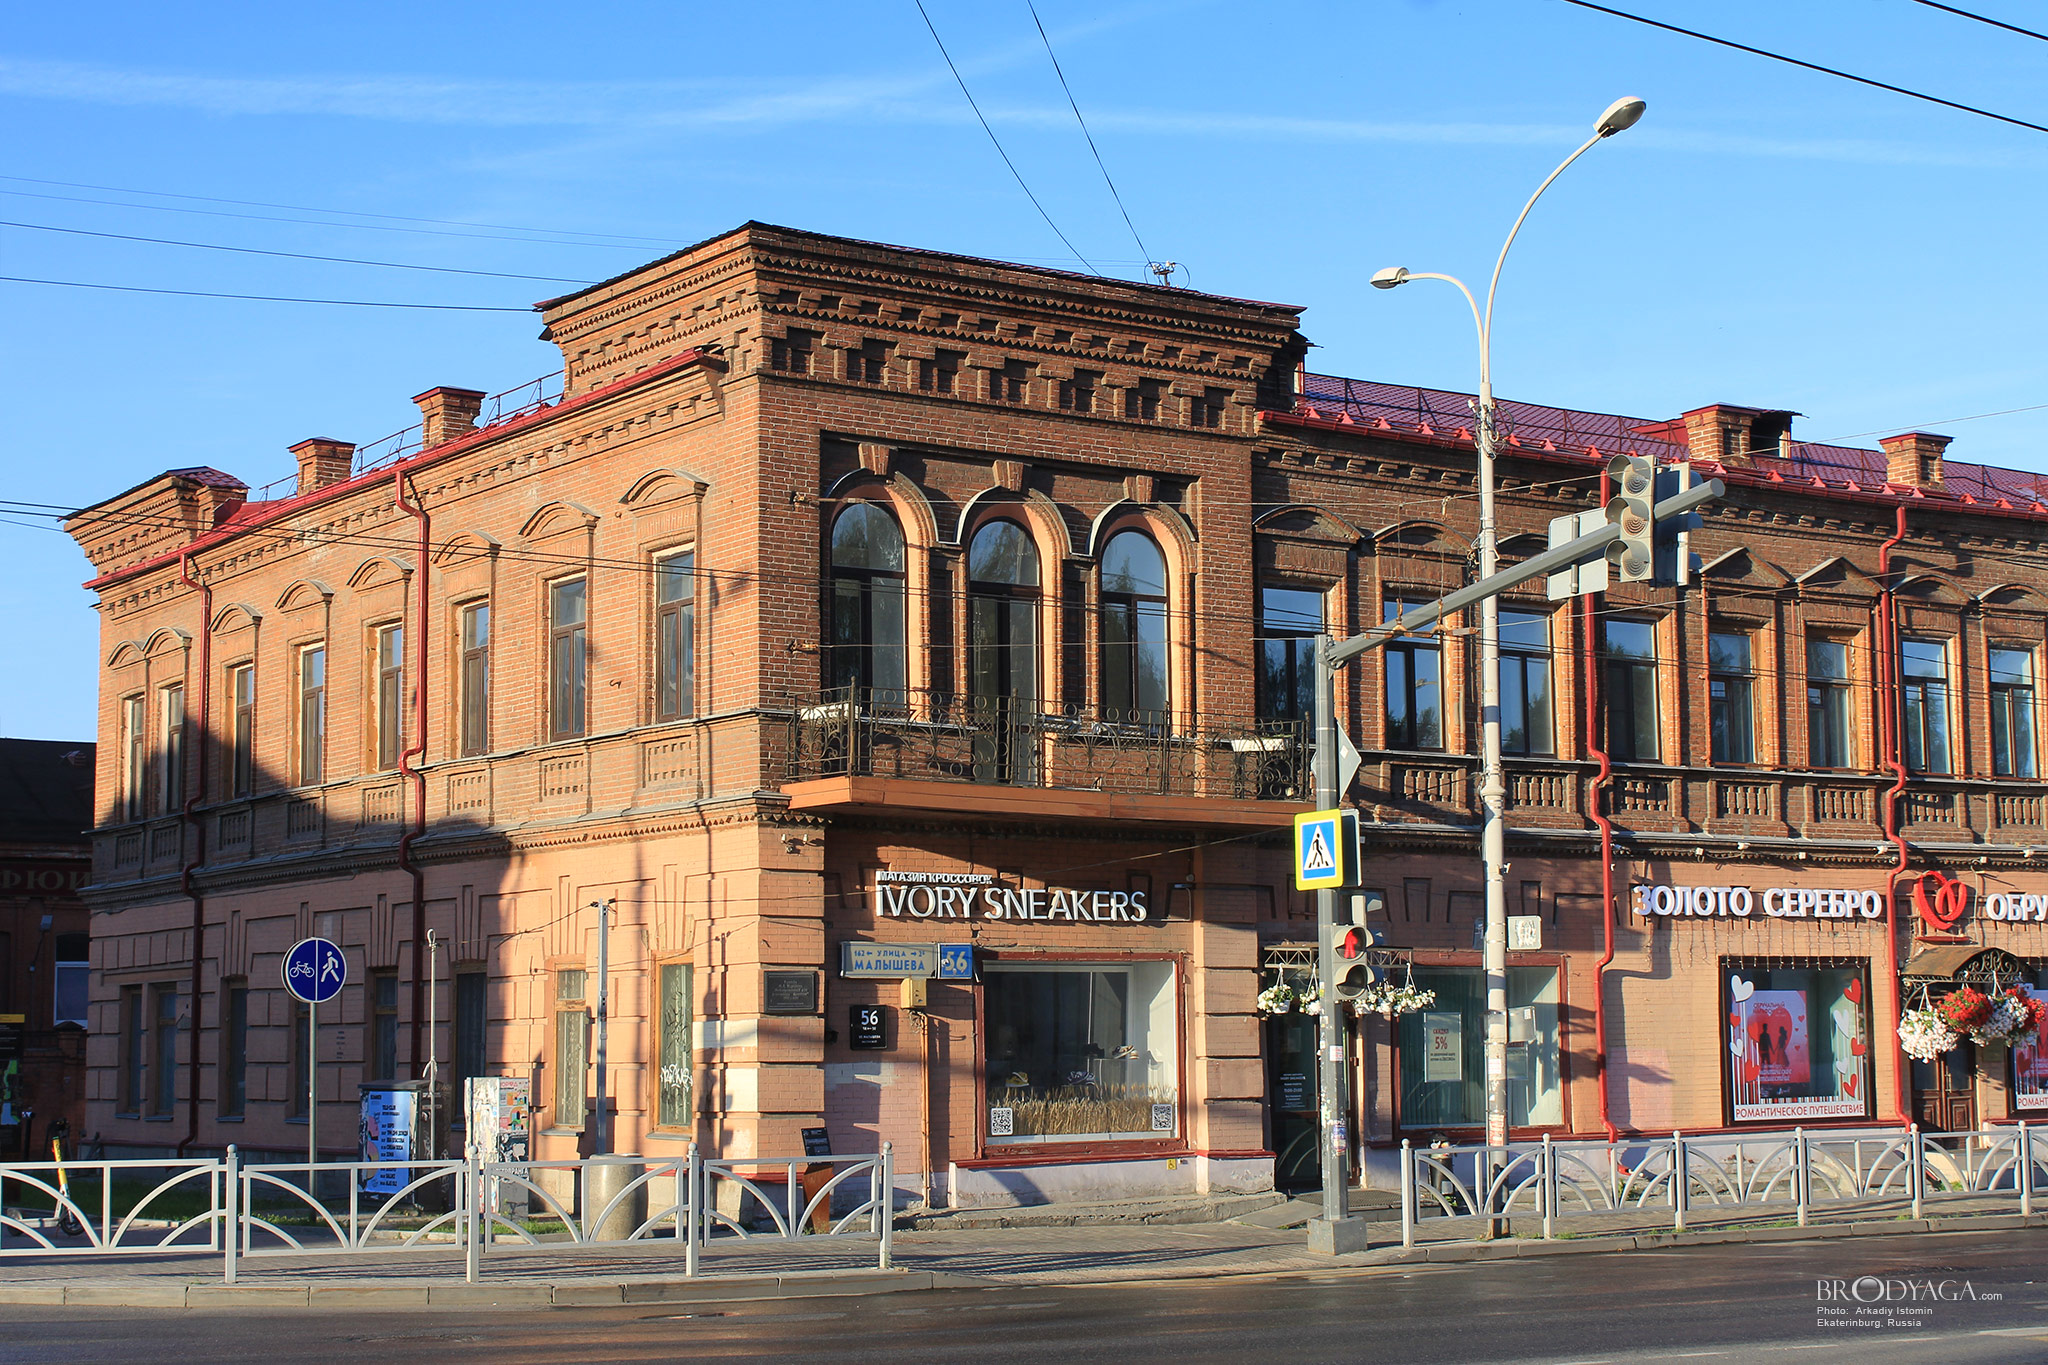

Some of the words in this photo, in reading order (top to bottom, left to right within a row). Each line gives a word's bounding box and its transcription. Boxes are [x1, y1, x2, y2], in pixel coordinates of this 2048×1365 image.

[876, 871, 926, 882] МАГАЗИН
[927, 873, 993, 884] КРОССОВОК
[876, 884, 977, 918] IVORY
[984, 887, 1147, 922] SNEAKERS
[1633, 885, 1753, 916] ЗОЛОТО
[1763, 887, 1882, 919] СЕРЕБРО
[877, 949, 906, 957] УЛИЦА
[854, 960, 926, 971] МАЛЫШЕВА
[944, 951, 968, 974] 56
[861, 1010, 879, 1026] 56
[1435, 1036, 1448, 1050] 5%
[1735, 1105, 1807, 1118] РОМАНТИЧЕСКОЕ
[1809, 1103, 1863, 1115] ПУТЕШЕСТВИЕ
